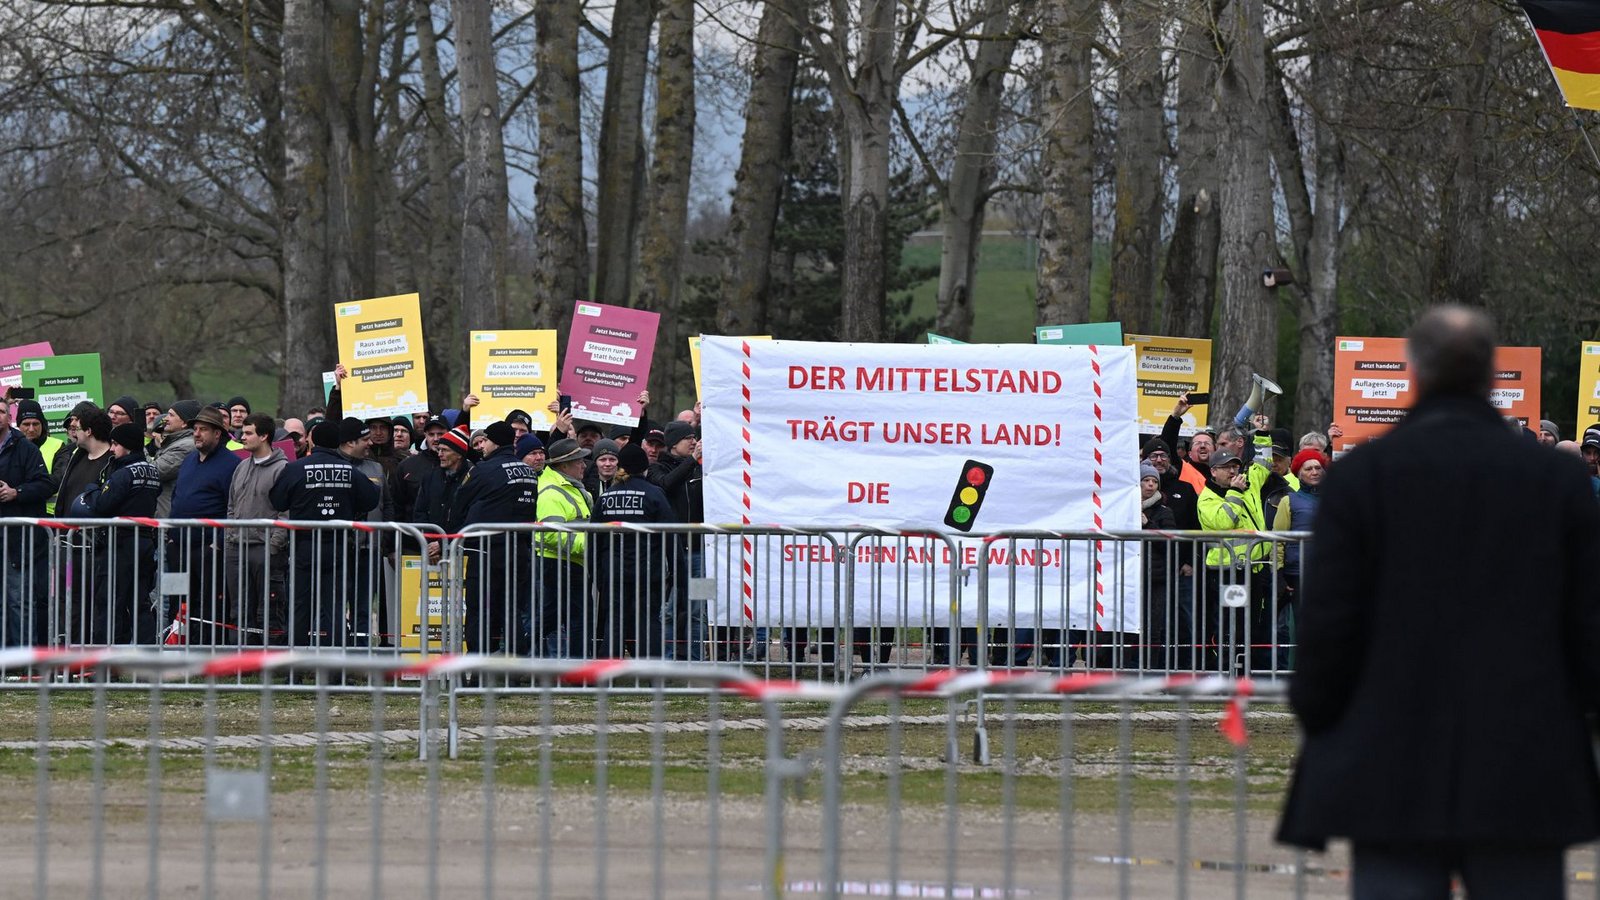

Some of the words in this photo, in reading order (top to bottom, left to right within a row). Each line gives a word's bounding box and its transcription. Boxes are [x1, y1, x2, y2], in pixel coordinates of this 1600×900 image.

[374, 320, 398, 328] handeln!
[608, 330, 632, 338] handeln!
[357, 344, 406, 357] Bürokratiewahn
[588, 344, 612, 352] Steuern
[613, 348, 632, 356] runter
[608, 354, 624, 362] hoch
[374, 363, 412, 373] zukunftsfähige
[1142, 362, 1192, 371] Bürokratiewahn
[364, 371, 403, 381] Landwirtschaft!
[584, 376, 624, 388] Landwirtschaft!
[596, 372, 634, 383] zukunftsfähige
[788, 366, 846, 390] DER
[856, 366, 1062, 394] MITTELSTAND
[41, 402, 70, 411] grardiesel
[787, 416, 875, 442] TRÄGT
[883, 422, 972, 444] UNSER
[981, 424, 1061, 446] LAND!
[306, 470, 352, 482] POLIZEI
[848, 482, 890, 504] DIE
[602, 496, 643, 509] POLIZEI
[903, 546, 934, 564] AN
